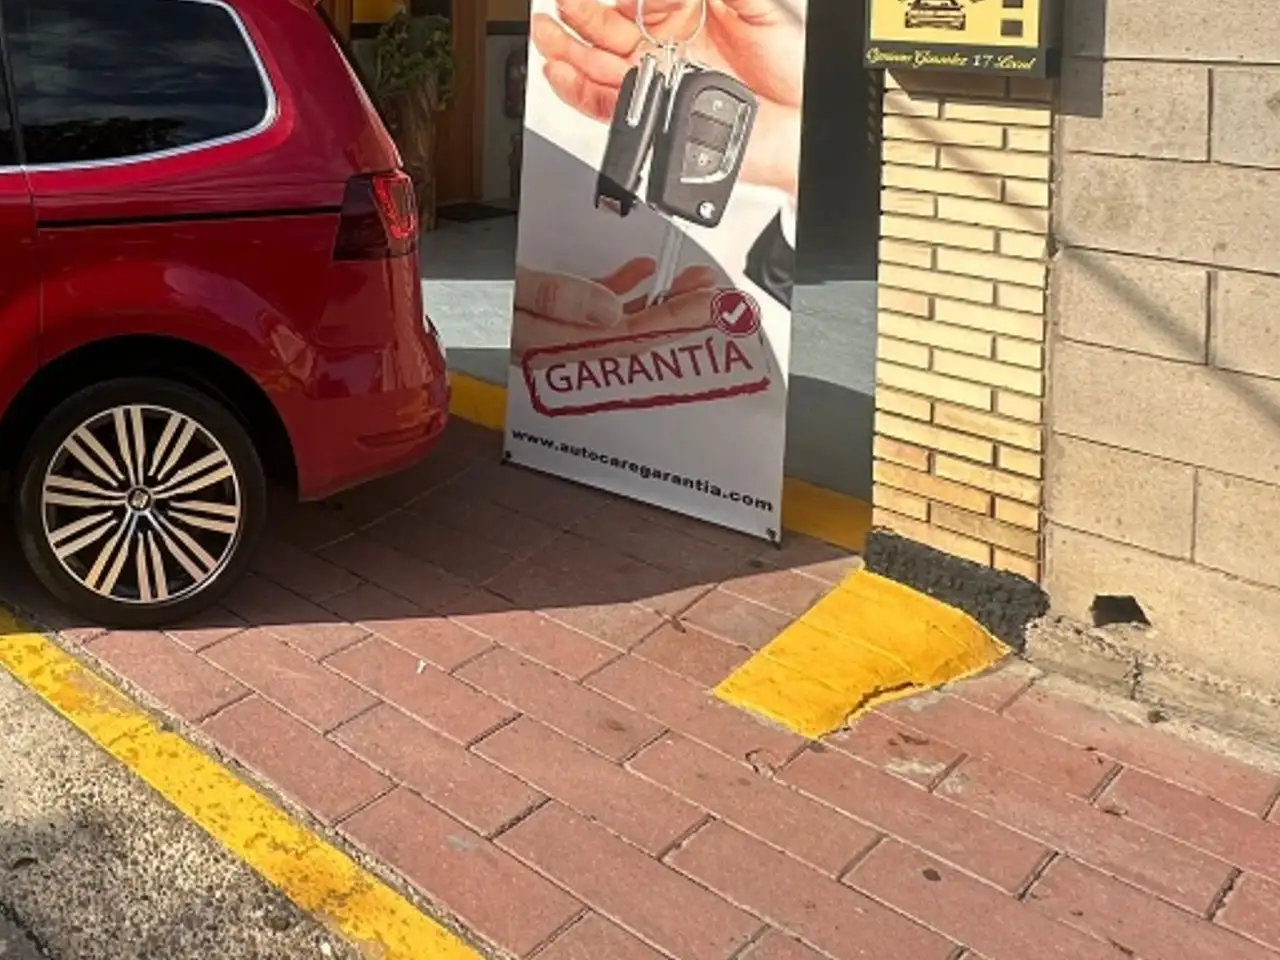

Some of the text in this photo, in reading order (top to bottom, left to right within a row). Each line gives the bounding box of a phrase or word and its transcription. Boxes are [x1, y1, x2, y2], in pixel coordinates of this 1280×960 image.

[972, 54, 994, 68] 17
[545, 336, 754, 393] GARANTÍA
[511, 428, 775, 514] www.autocaregarantia.com
